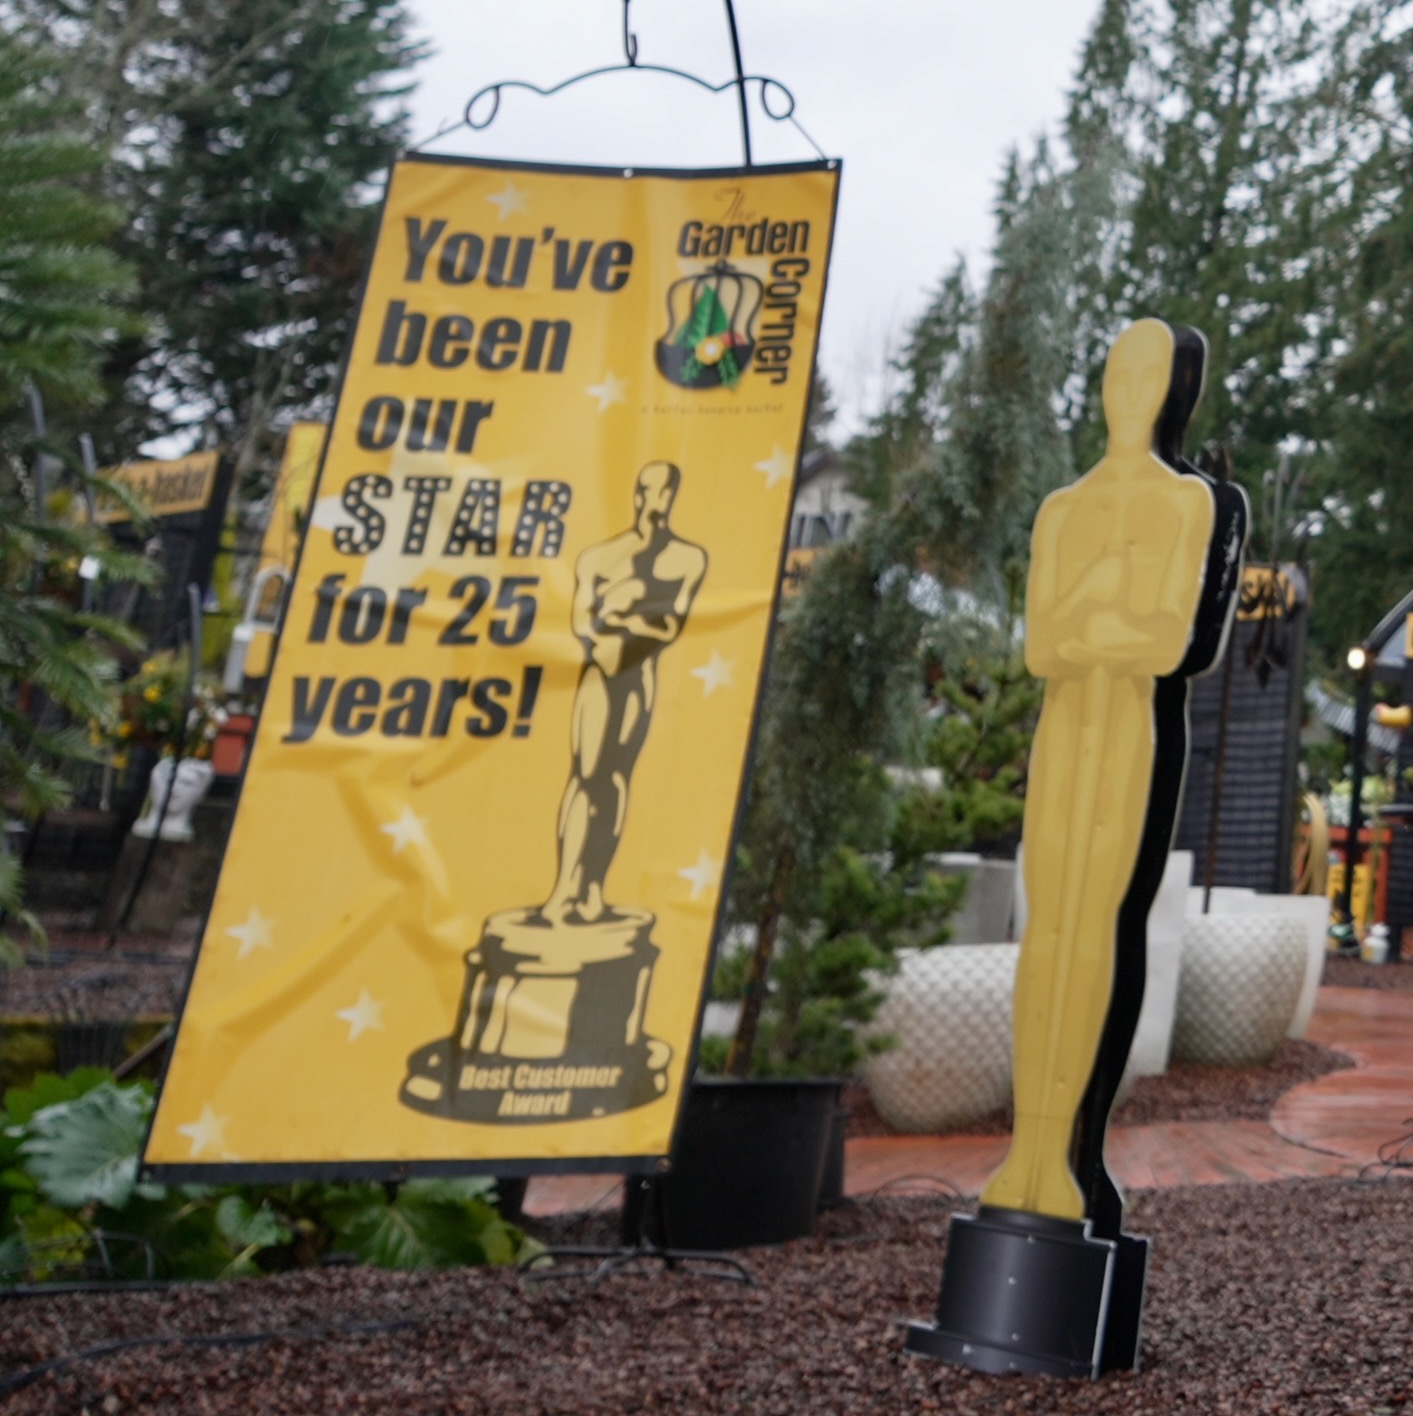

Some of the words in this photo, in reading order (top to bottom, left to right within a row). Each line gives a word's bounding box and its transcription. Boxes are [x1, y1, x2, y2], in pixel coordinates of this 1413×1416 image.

[676, 217, 811, 258] Garden
[713, 186, 757, 222] The
[403, 215, 635, 294] You've
[374, 299, 573, 374] been
[753, 257, 811, 385] Corner
[355, 395, 495, 454] our
[331, 473, 573, 558] STAR
[306, 573, 429, 645] for
[436, 575, 541, 647] 25
[280, 664, 545, 745] years!
[458, 1063, 512, 1091] Best
[513, 1063, 624, 1090] Customer
[497, 1089, 573, 1117] Award
